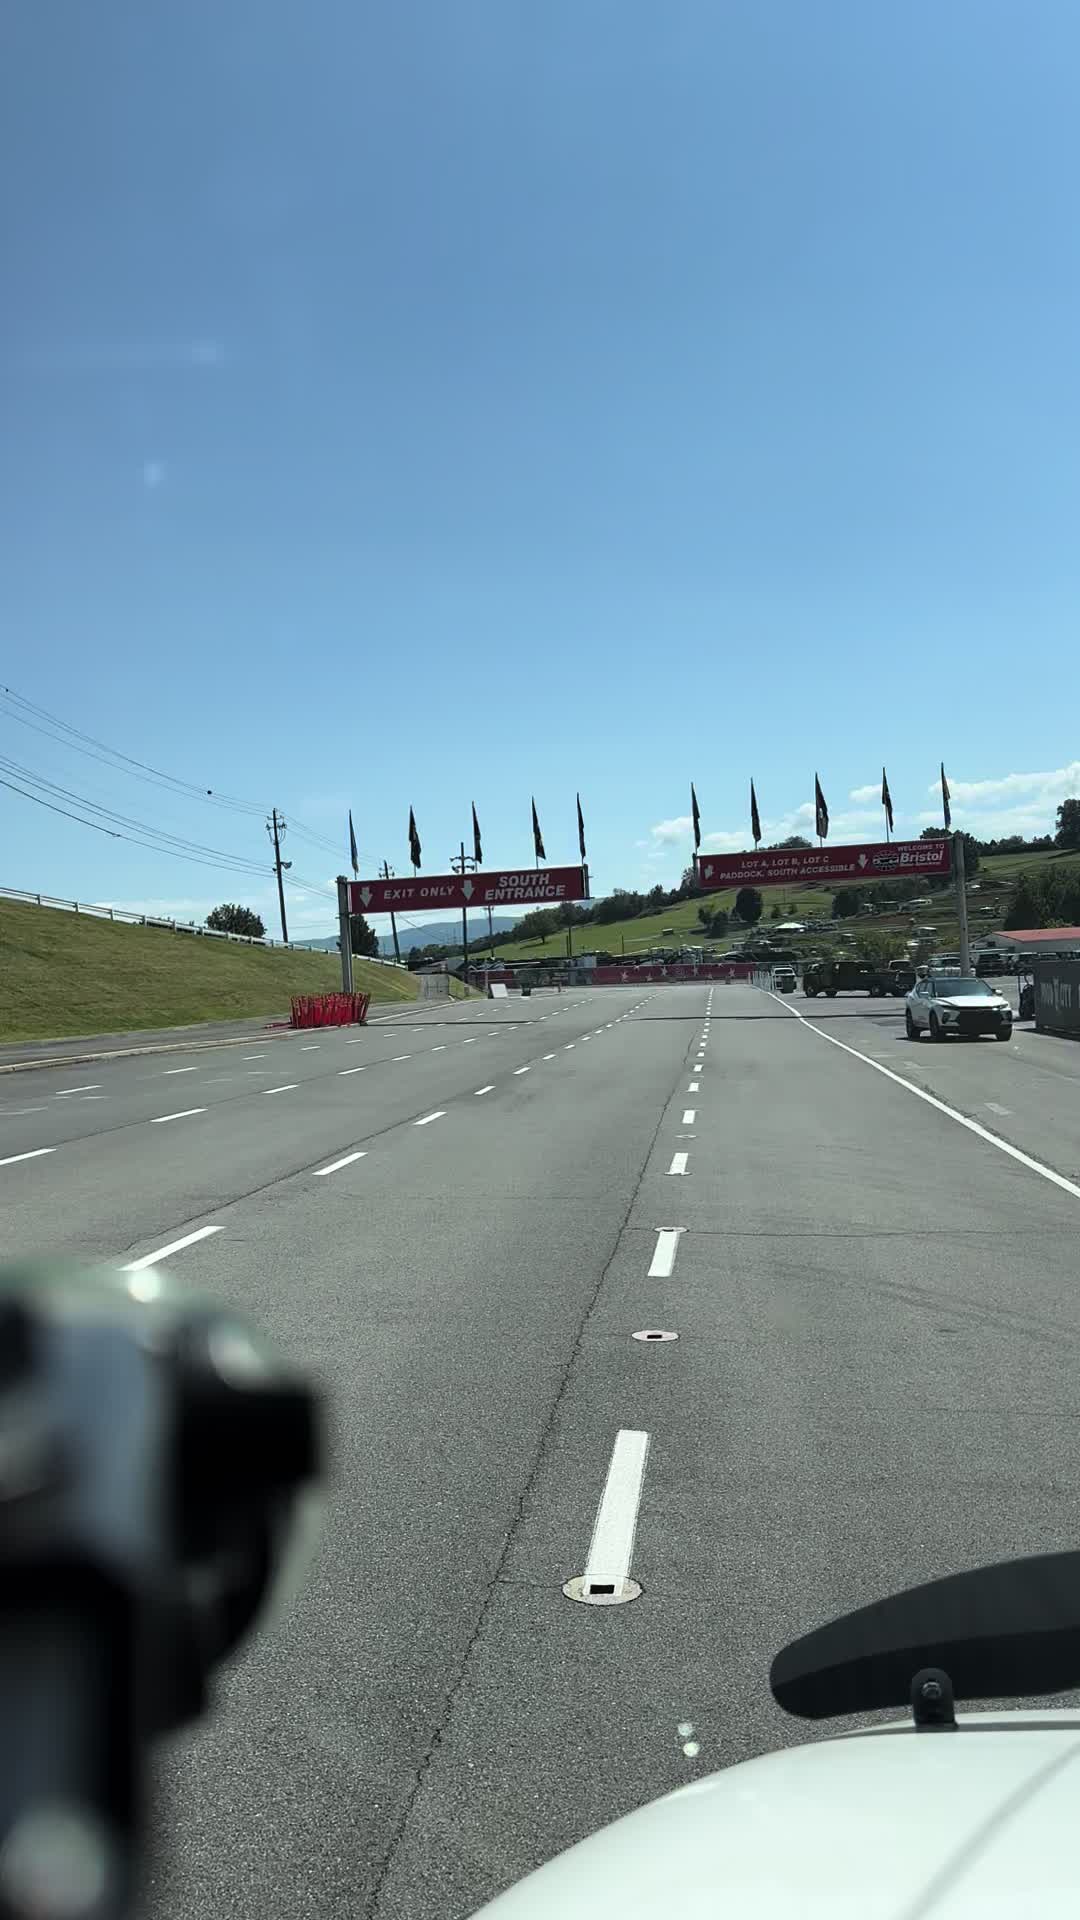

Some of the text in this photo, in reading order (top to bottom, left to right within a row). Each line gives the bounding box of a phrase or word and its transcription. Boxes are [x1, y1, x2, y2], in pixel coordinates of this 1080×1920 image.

[897, 844, 933, 852] WELCOME
[741, 860, 758, 869] LOT
[772, 858, 789, 867] LOT
[803, 857, 820, 865] LOT
[823, 855, 830, 863] C
[900, 850, 944, 863] Bristol
[767, 867, 798, 877] SOUTH
[800, 863, 856, 875] ACCESSIBLE
[498, 873, 550, 888] SOUTH
[384, 885, 455, 900] EXIT ONLY
[485, 884, 566, 901] ENTRANCE
